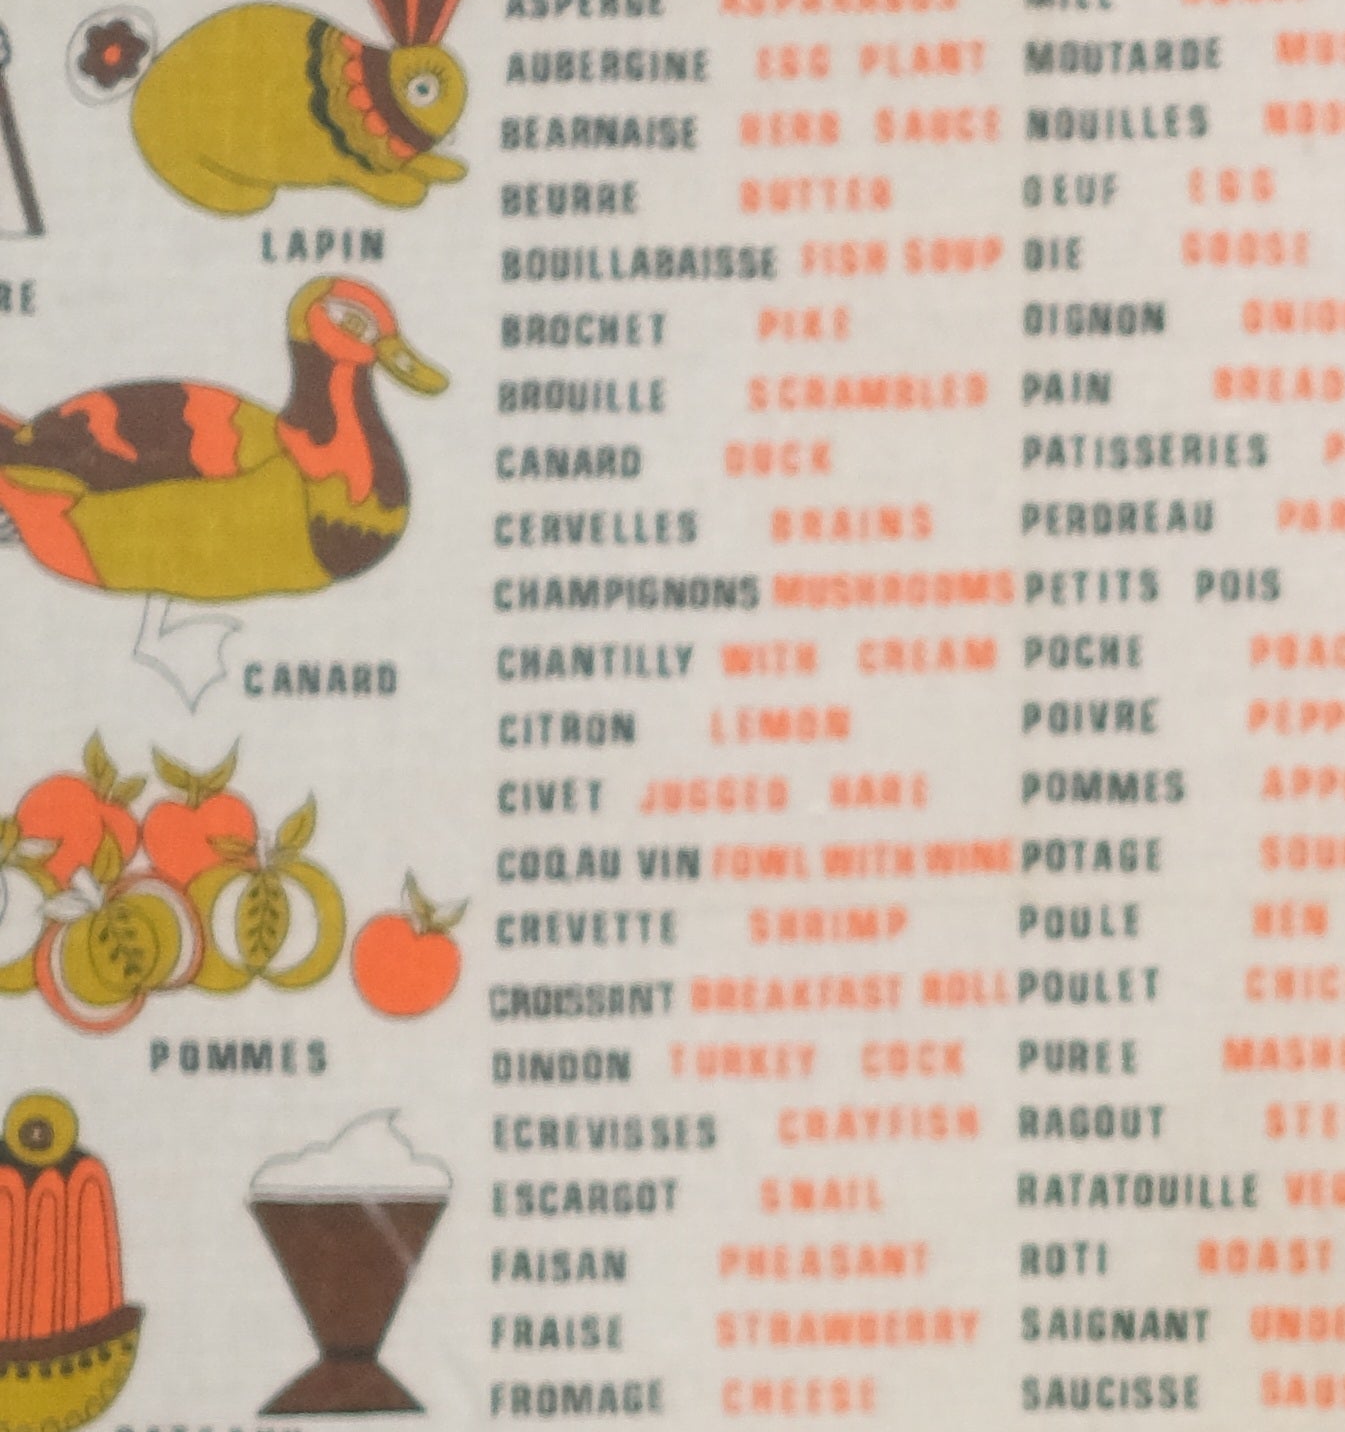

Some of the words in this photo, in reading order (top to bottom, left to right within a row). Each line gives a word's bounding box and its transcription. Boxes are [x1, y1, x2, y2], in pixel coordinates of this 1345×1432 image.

[506, 48, 708, 84] AUBERGINE
[1024, 36, 1221, 74] MOUTARDE
[501, 115, 698, 151] BEARNAISE
[1026, 104, 1210, 141] NOUILLES
[501, 181, 637, 217] BEURRE
[1022, 173, 1117, 208] OEUF
[262, 229, 384, 263] LAPIN
[501, 245, 777, 283] BOUILLABAISSE
[1024, 236, 1081, 272] OIE
[501, 313, 665, 349] BROCHET
[1023, 301, 1166, 337] OIGNON
[497, 378, 665, 415] BROUILLE
[1022, 371, 1111, 405] PAIN
[496, 444, 641, 480] CANARD
[1023, 432, 1269, 469] PATISSERIES
[494, 509, 698, 548] CERVELLES
[1021, 500, 1215, 536] PERDREAU
[493, 574, 761, 613] CHAMPIGNONS
[1025, 568, 1160, 606] PETITS
[1195, 567, 1281, 602] POIS
[497, 644, 693, 681] CHANTILLY
[1024, 634, 1142, 669] POCHE
[243, 662, 397, 698] CANARD
[499, 712, 636, 749] CITRON
[1022, 697, 1158, 735] POIVRE
[497, 778, 602, 816] CIVET
[1021, 769, 1186, 805] POMMES
[637, 846, 701, 880] VIN
[1022, 837, 1160, 873] POTAGE
[496, 910, 676, 948] CREVETTE
[1019, 902, 1139, 941] POULE
[1018, 966, 1159, 1005] POULET
[150, 1040, 327, 1076] POMMES
[492, 1048, 631, 1085] DINDON
[1018, 1039, 1136, 1075] PUREE
[493, 1114, 718, 1152] ECREVISSES
[1018, 1104, 1164, 1140] RAGOUT
[492, 1178, 678, 1217] ESCARGOT
[1017, 1172, 1257, 1209] RATATOUILLE
[491, 1249, 627, 1283] FAISAN
[1020, 1240, 1107, 1278] ROTI
[491, 1315, 622, 1349] FRAISE
[1021, 1307, 1209, 1342] SAIGNANT
[490, 1378, 663, 1418] FROMAGE
[1021, 1374, 1199, 1411] SAUCISSE
